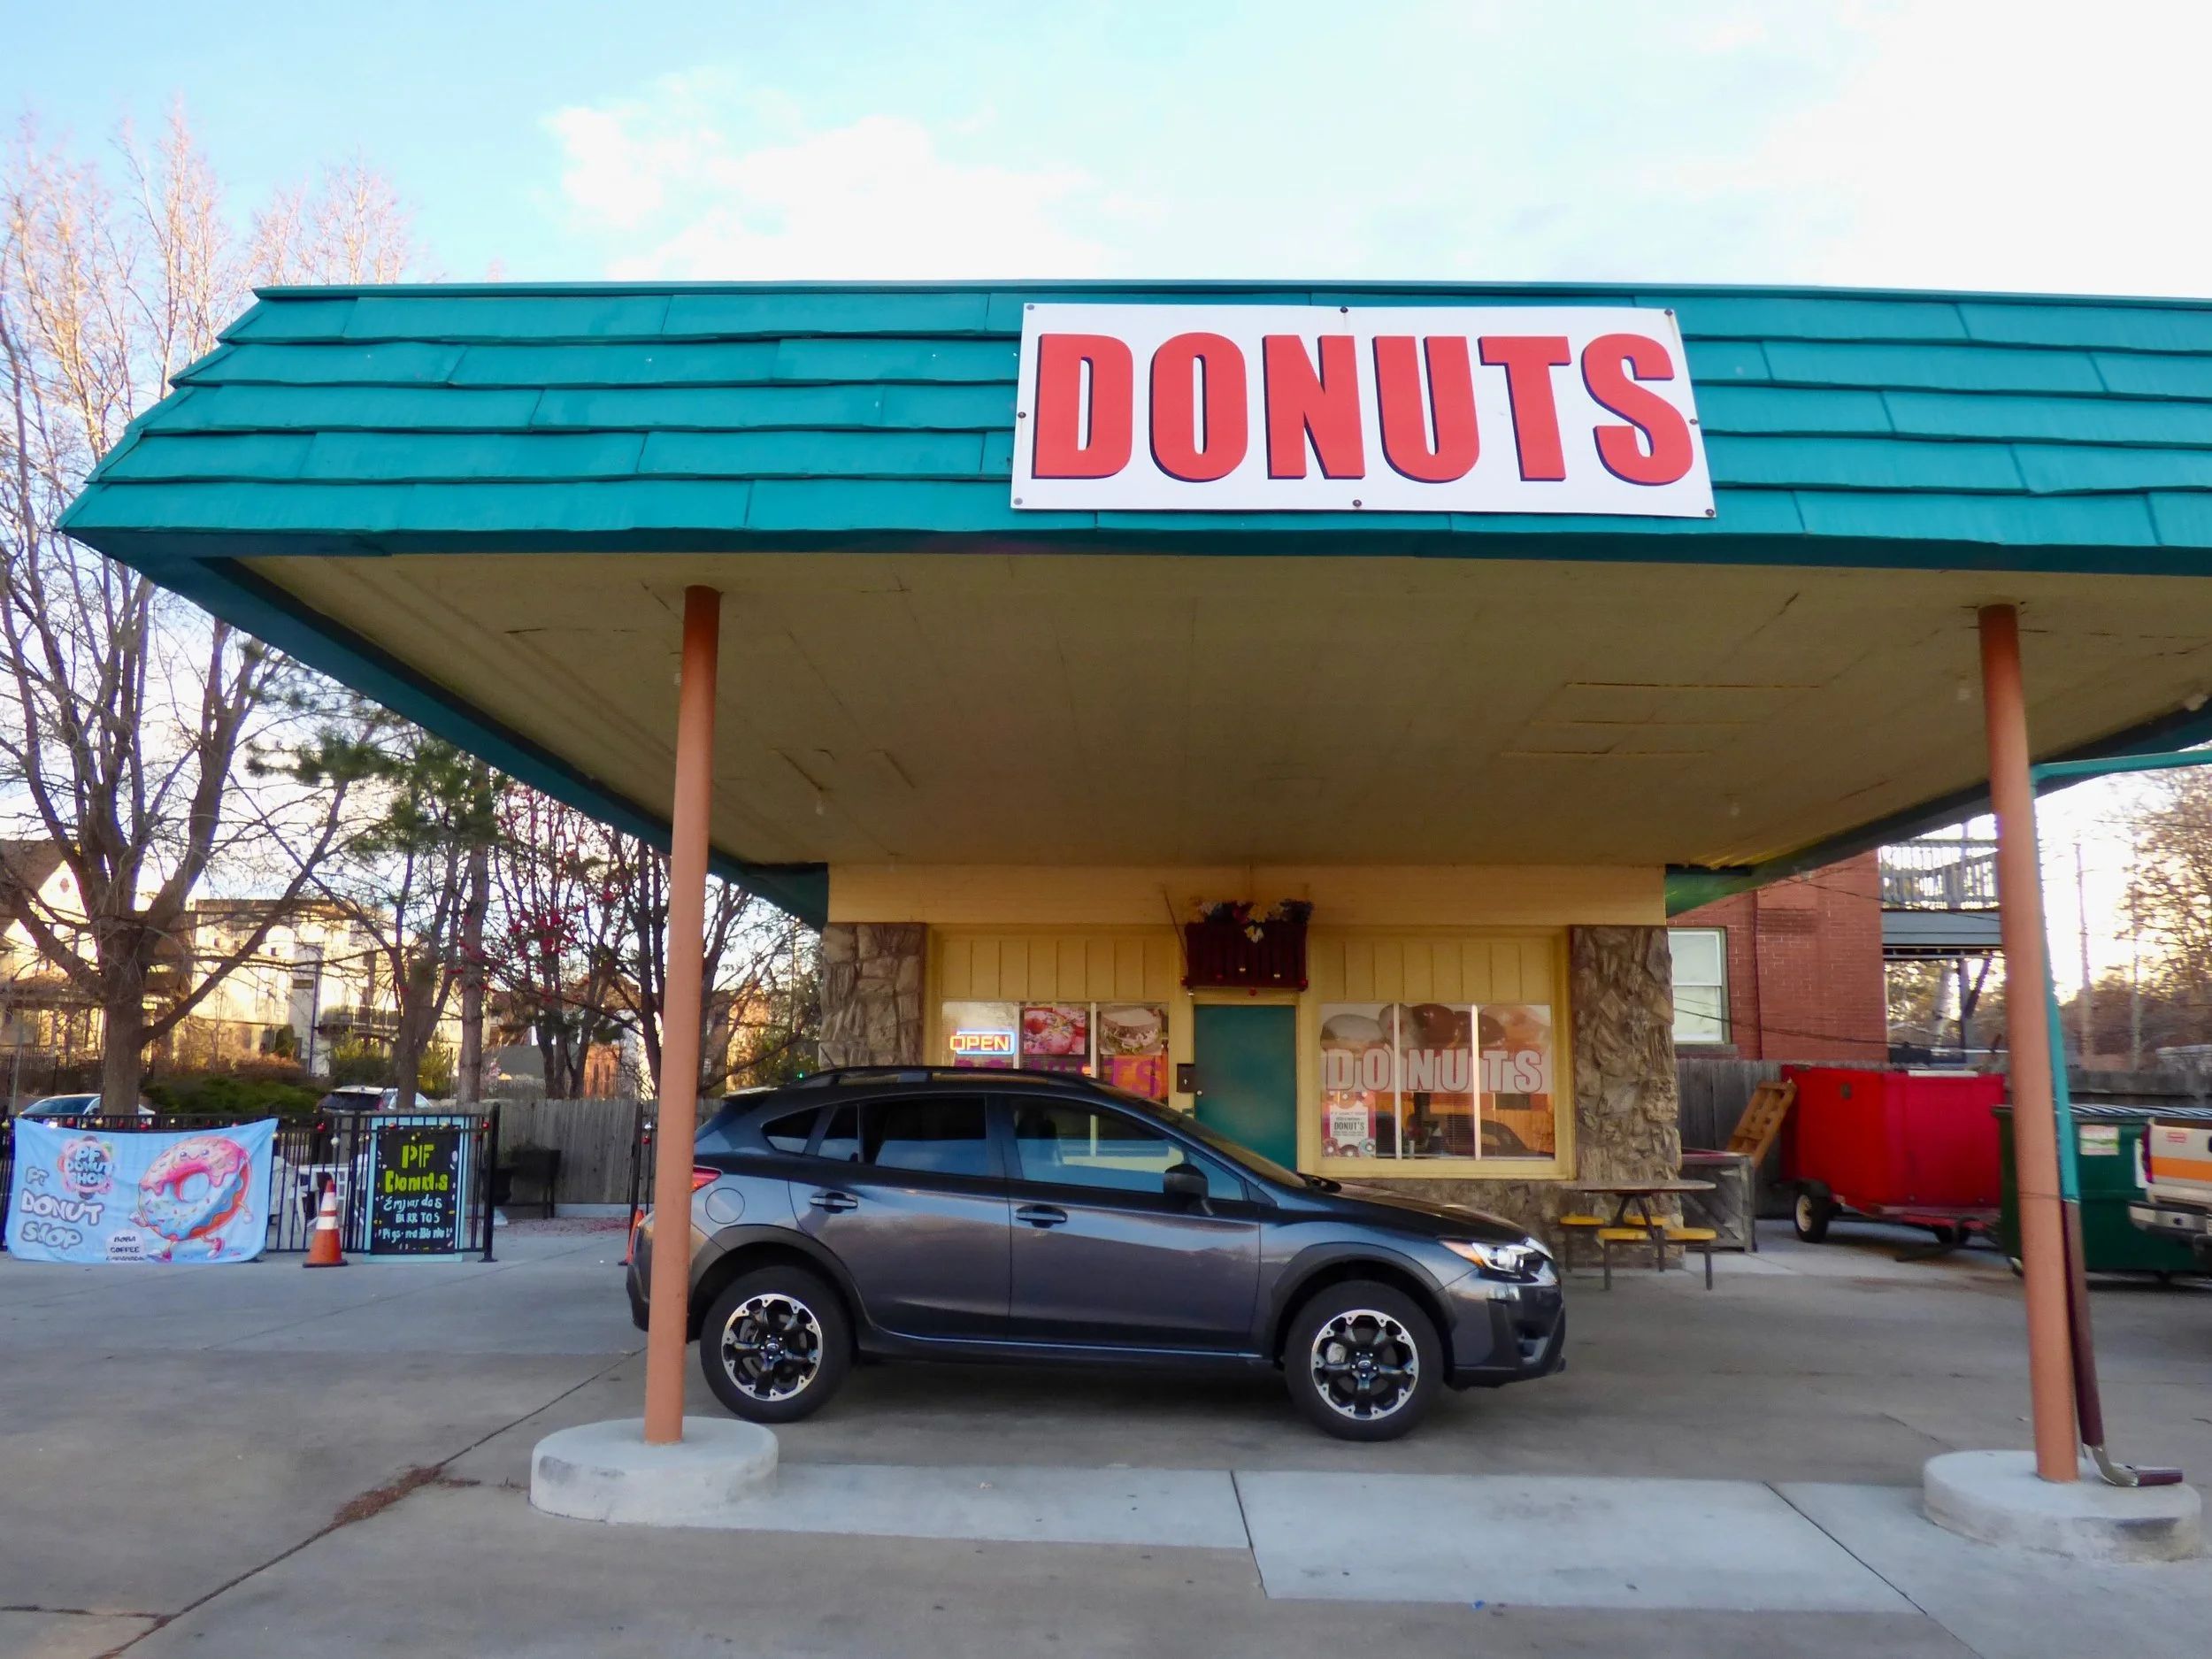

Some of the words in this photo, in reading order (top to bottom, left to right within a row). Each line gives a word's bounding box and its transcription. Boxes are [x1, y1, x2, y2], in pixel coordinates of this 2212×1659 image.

[1031, 332, 1694, 487] DONUTS
[949, 1034, 1010, 1051] OPEN
[1325, 1047, 1542, 1094] DONUTS
[75, 1145, 101, 1163] PF
[402, 1144, 435, 1168] PF
[20, 1187, 105, 1226] DONUT
[395, 1212, 441, 1224] BURRTOS
